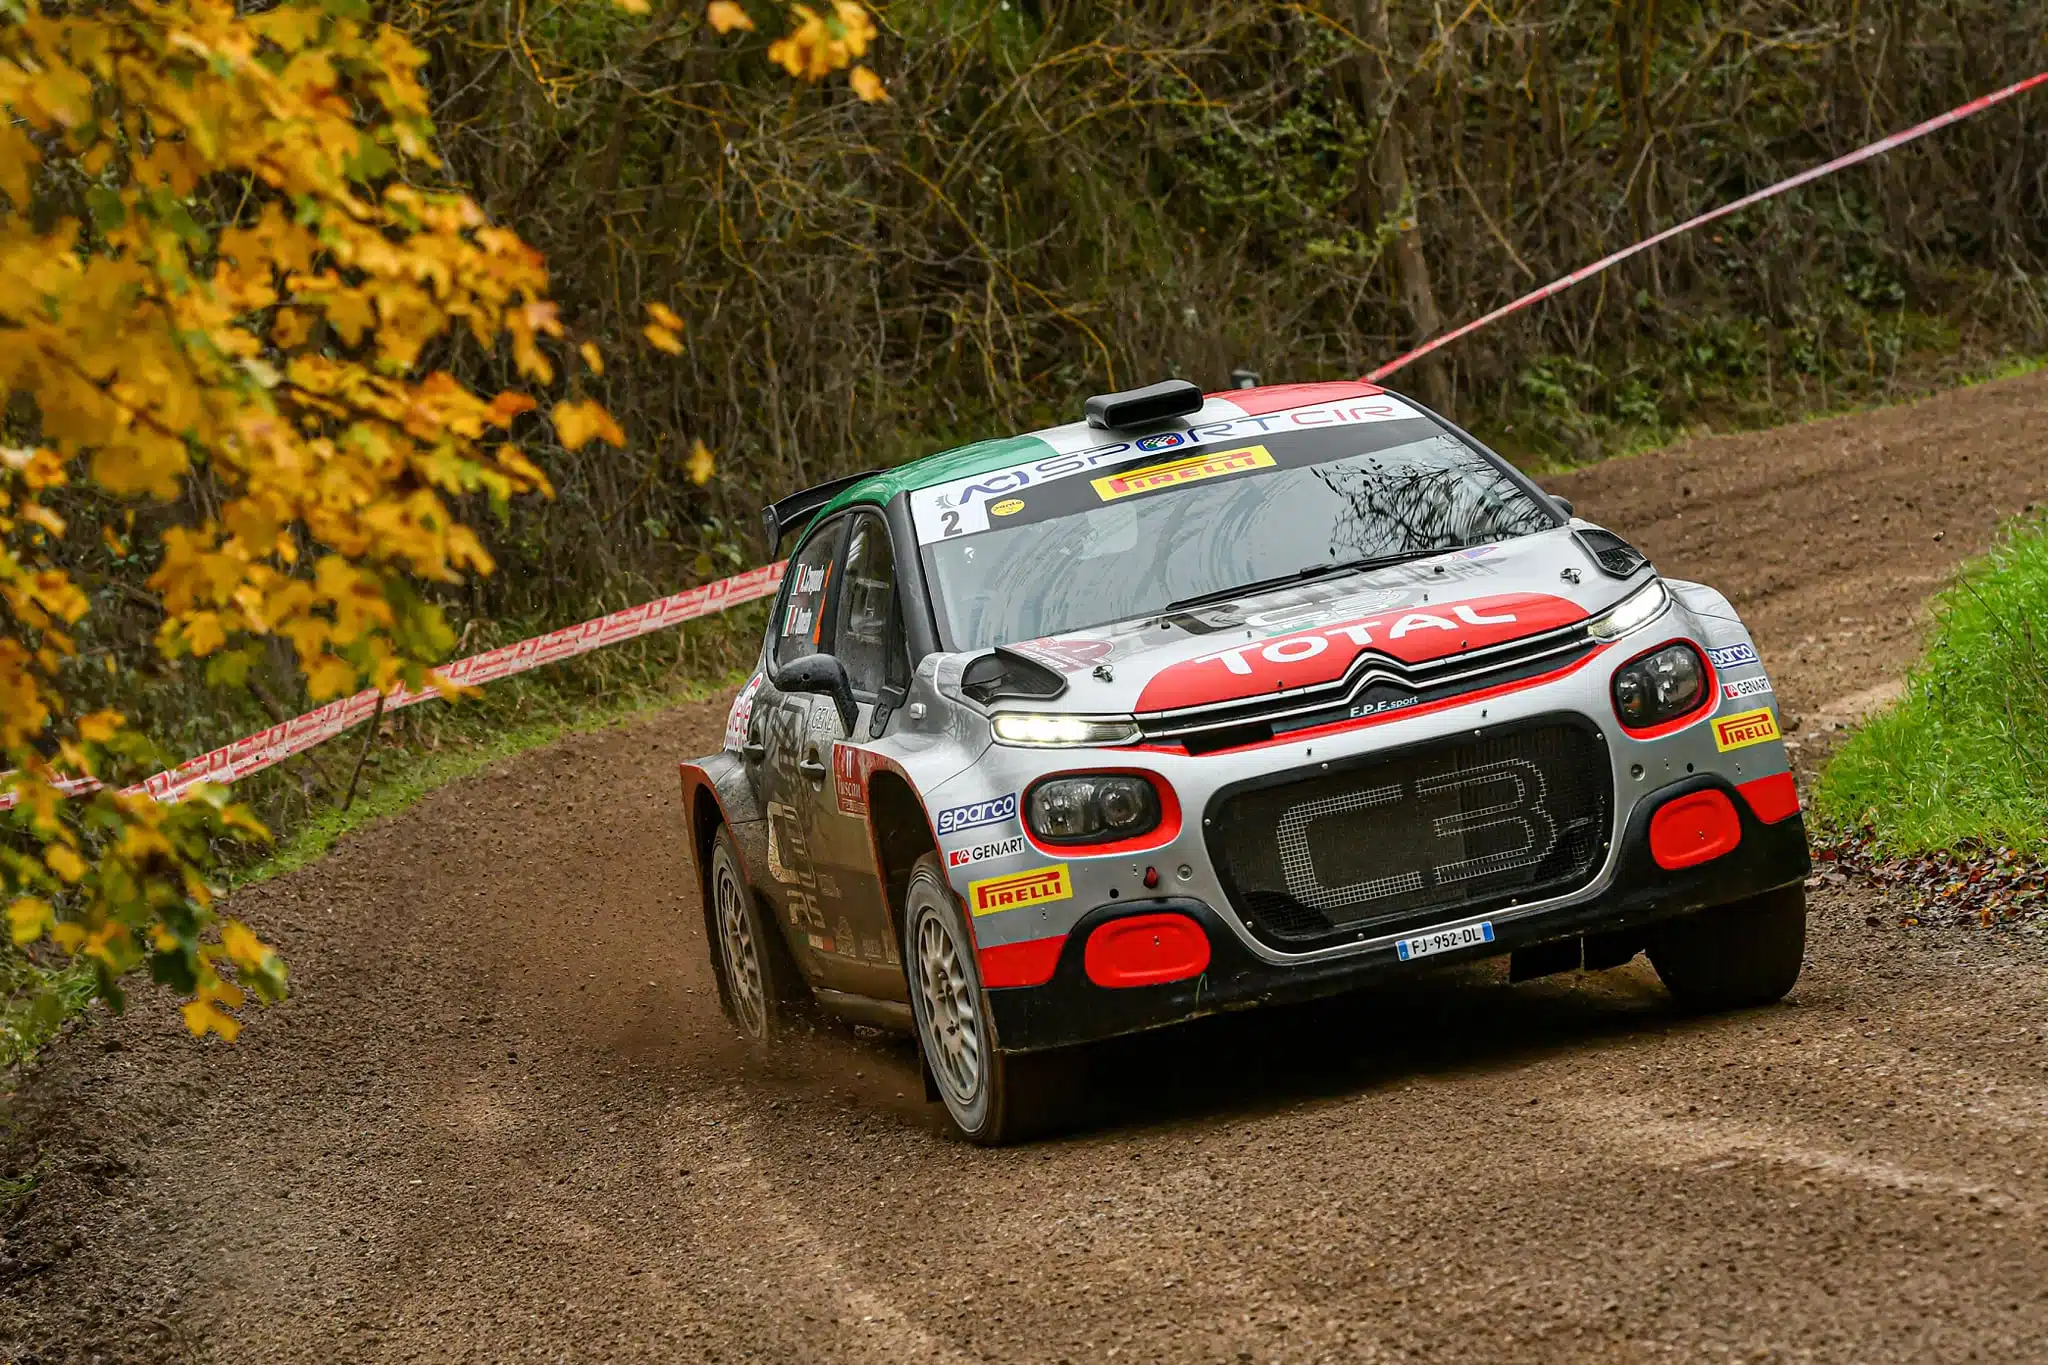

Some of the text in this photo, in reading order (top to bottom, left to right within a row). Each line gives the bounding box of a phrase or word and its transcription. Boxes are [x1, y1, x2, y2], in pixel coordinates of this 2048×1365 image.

[1290, 405, 1393, 426] CIR
[1109, 452, 1256, 494] PIRELLI
[941, 511, 963, 537] 2
[1195, 604, 1517, 676] TOTAL
[1737, 678, 1770, 695] GENART
[1718, 714, 1774, 746] PIRELLI
[939, 796, 1015, 832] sparco
[972, 837, 1023, 861] GENART
[1276, 758, 1558, 910] C3
[977, 871, 1062, 910] PIRELLI
[1411, 927, 1481, 955] FJ-952-DL
